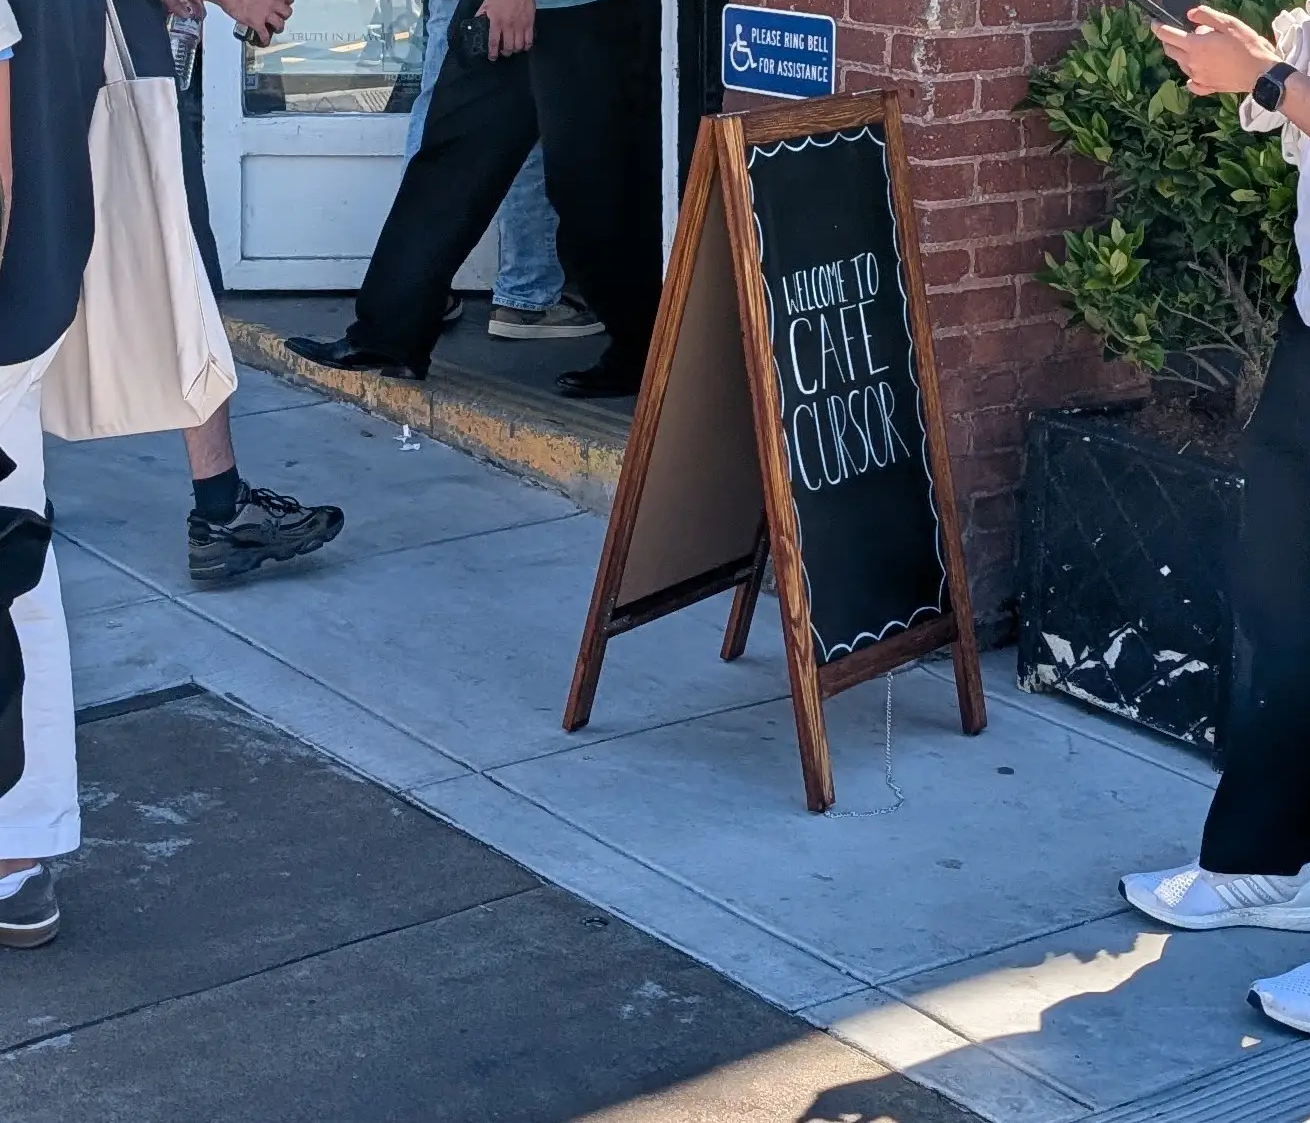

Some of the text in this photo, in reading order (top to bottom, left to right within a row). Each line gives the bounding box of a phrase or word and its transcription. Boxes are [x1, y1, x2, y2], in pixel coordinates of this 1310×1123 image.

[291, 32, 328, 41] TRUTH
[332, 32, 344, 41] IN
[751, 27, 828, 53] PLEASE RING BELL
[759, 58, 828, 83] FOR ASSISTANCE
[782, 252, 879, 315] WELCOME TO
[789, 299, 889, 395] CAFE
[793, 381, 911, 491] CURSOR
